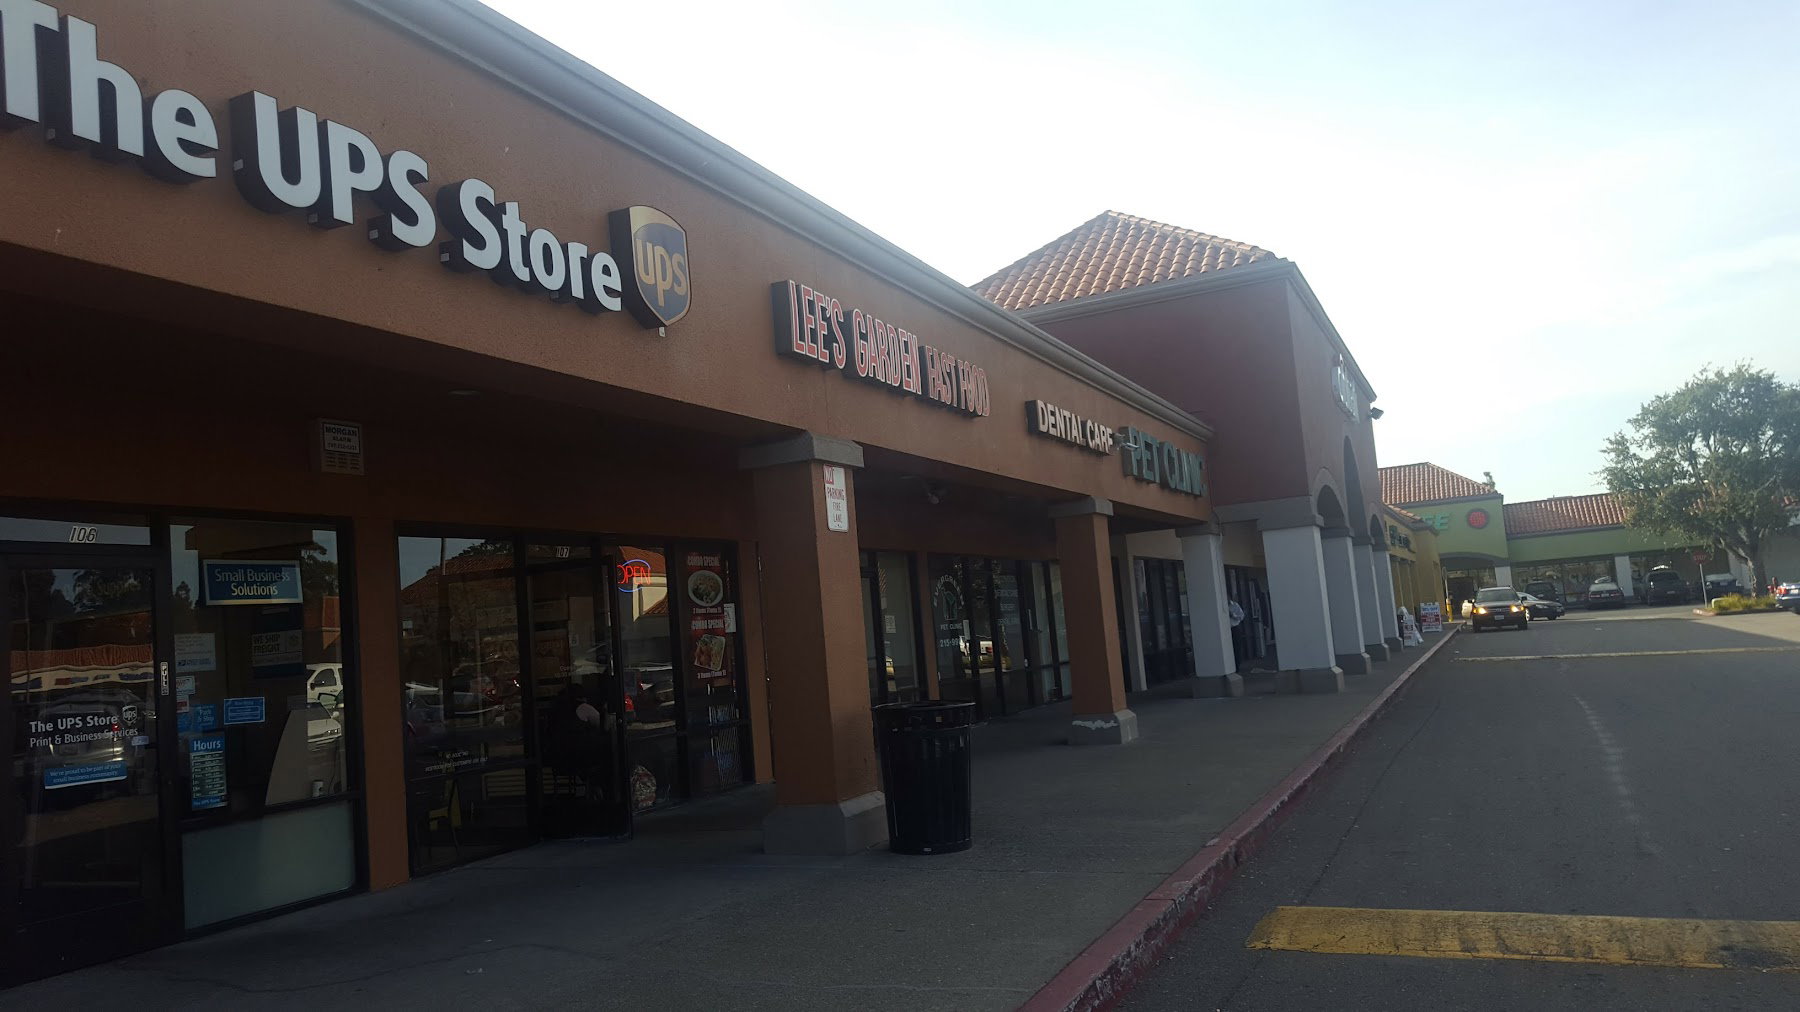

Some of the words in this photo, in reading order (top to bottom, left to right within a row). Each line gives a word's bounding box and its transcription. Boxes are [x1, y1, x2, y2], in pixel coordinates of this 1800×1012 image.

[0, 0, 218, 178] The
[254, 90, 436, 247] UPS
[459, 178, 622, 311] Store
[635, 247, 687, 308] ups
[788, 280, 846, 369] LEE'S
[851, 309, 922, 395] GARDEN
[926, 345, 958, 408] FAST
[958, 359, 990, 416] FOOD
[326, 426, 357, 436] MORGAN
[1037, 400, 1086, 446] DENTAL
[1086, 419, 1113, 454] CARE
[1129, 427, 1161, 483] PET
[70, 526, 97, 543] 106
[214, 568, 244, 582] Small
[247, 567, 290, 582] Business
[617, 564, 651, 585] OPEN
[231, 582, 279, 596] Solutions
[29, 721, 54, 733] The
[58, 716, 83, 730] UPS
[86, 715, 118, 728] Store
[30, 736, 52, 748] Print
[55, 734, 63, 745] &
[65, 732, 103, 744] Business
[104, 727, 138, 739] Services
[193, 740, 221, 751] Hours
